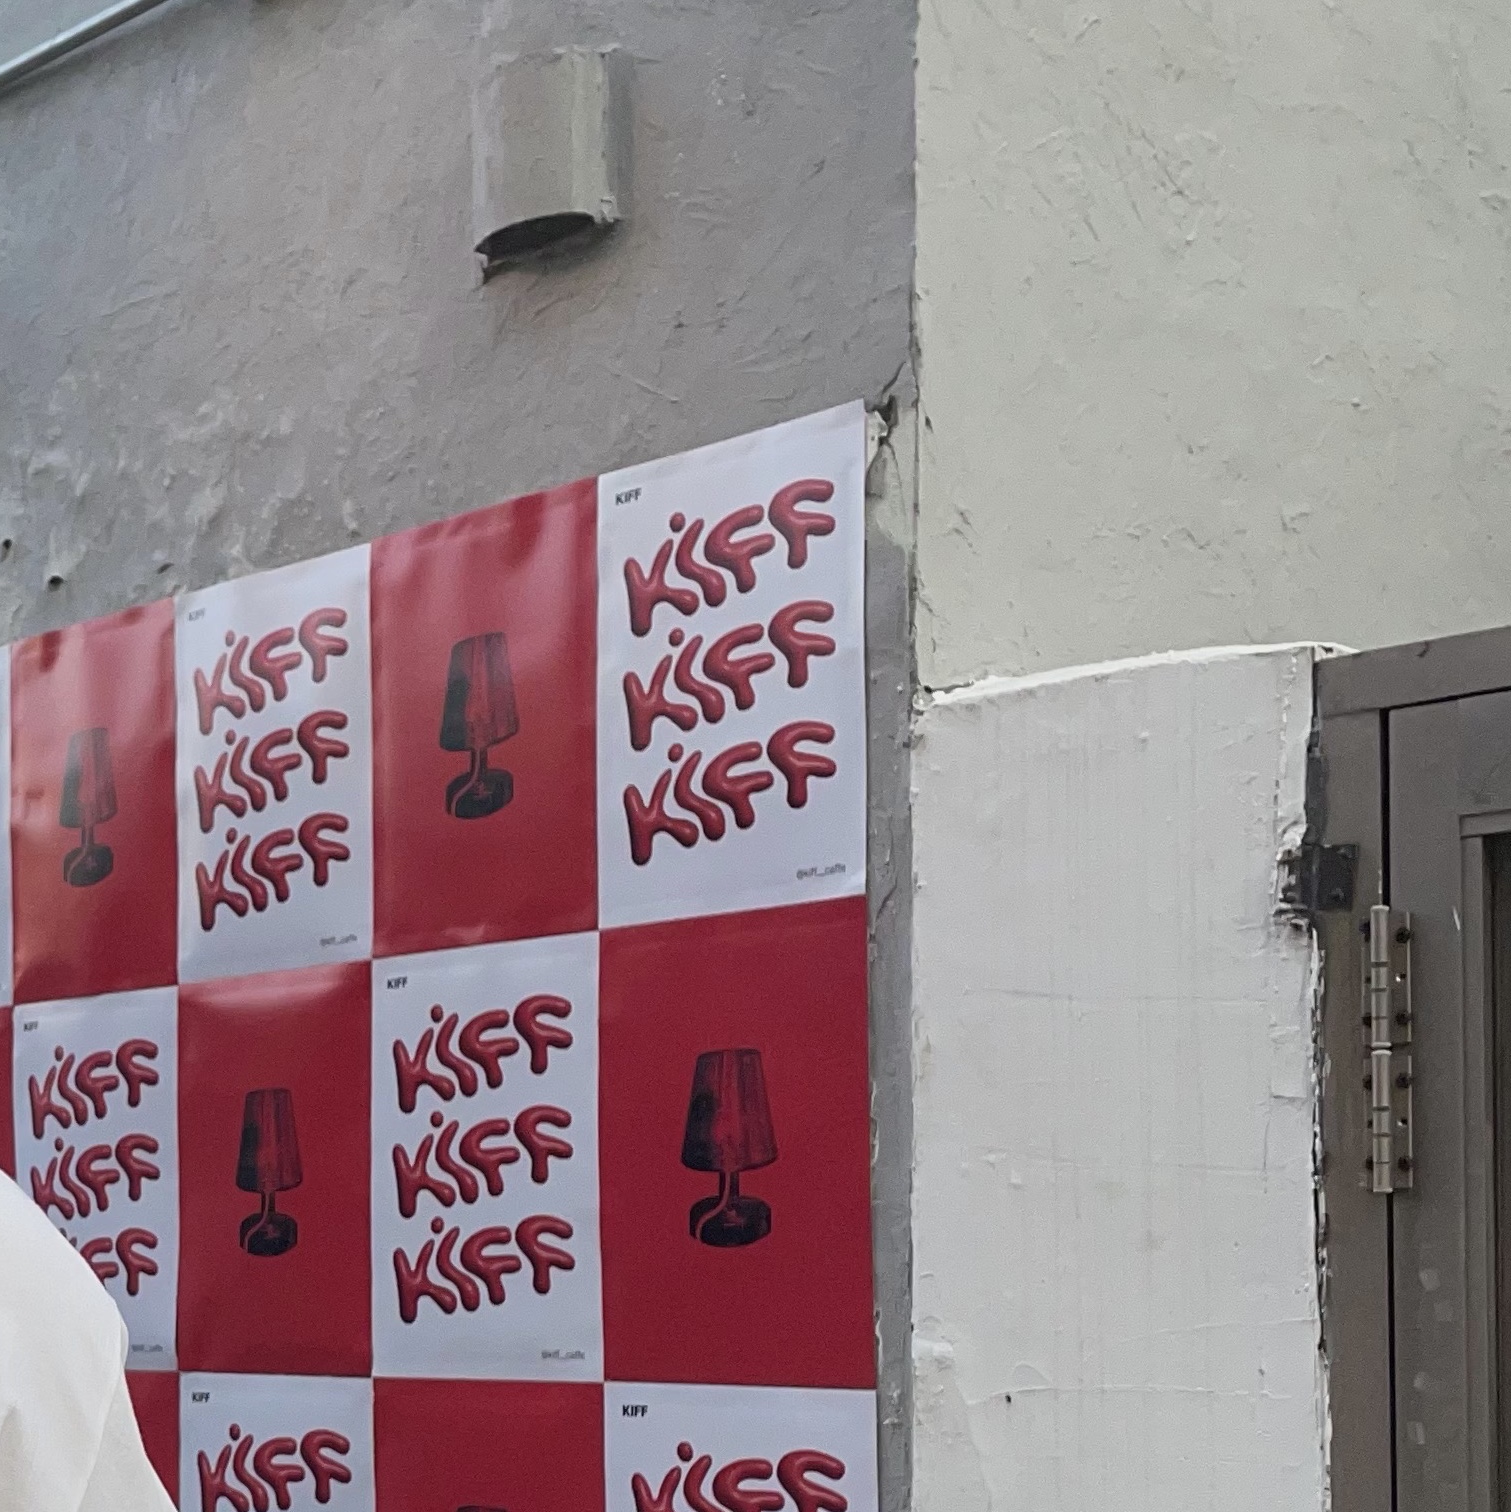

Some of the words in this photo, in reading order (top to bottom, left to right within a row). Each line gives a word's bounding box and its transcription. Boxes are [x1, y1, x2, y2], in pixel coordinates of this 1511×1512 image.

[614, 487, 642, 506] KIFF
[386, 976, 408, 990] KIFF
[621, 1403, 648, 1418] KIFF
